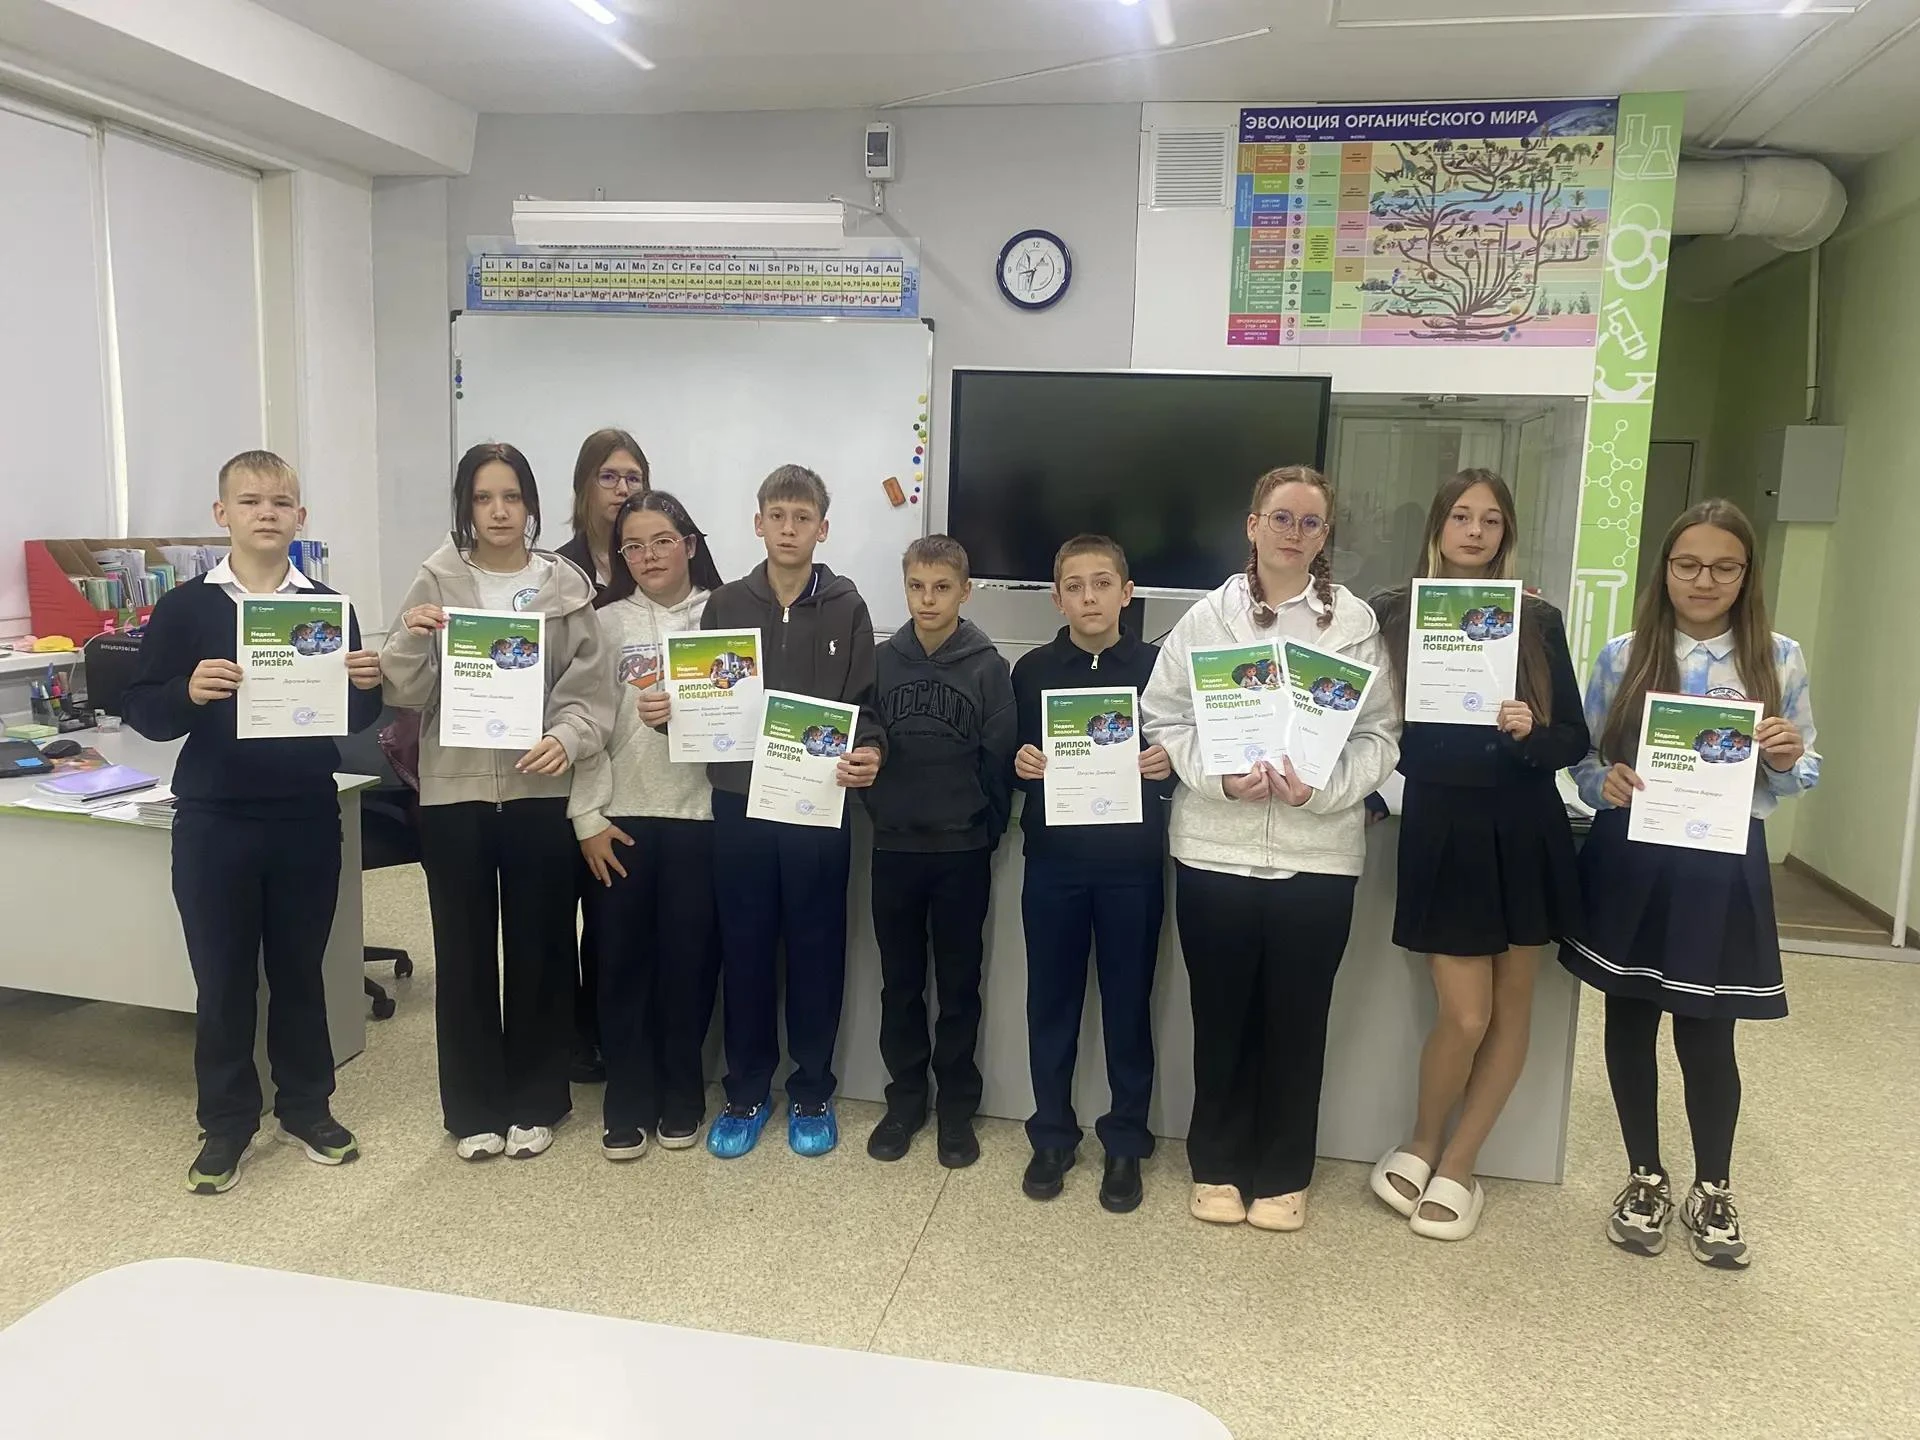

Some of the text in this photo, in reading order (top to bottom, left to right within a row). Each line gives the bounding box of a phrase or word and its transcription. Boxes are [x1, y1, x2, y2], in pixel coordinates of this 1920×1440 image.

[1245, 110, 1538, 131] ЭВОЛЮЦИЯ ОРГАНИЧЕСКОГО МИРА
[595, 263, 609, 272] Mg
[808, 265, 818, 274] H2
[846, 265, 859, 274] Hg
[866, 265, 879, 274] Ag
[1423, 634, 1464, 643] ДИПЛОМ
[1422, 643, 1484, 652] ПОБЕДИТЕЛЯ
[251, 650, 294, 659] ДИПЛОМ
[252, 658, 294, 667] ПРИЗЁРА
[454, 661, 493, 671] ДИПЛОМ
[454, 669, 492, 678] ПРИЗЁРА
[678, 683, 715, 692] ДИПЛОМ
[679, 691, 734, 699] ПОБЕДИТЕЛЯ
[1205, 694, 1241, 702] ДИПЛОМ
[1206, 699, 1261, 709] ПОБЕДИТЕЛЯ
[767, 742, 804, 755] ДИПЛОМ
[1055, 741, 1091, 749] ДИПЛОМ
[766, 750, 801, 762] ПРИЗЁРА
[1055, 748, 1090, 757] ПРИЗЁРА
[1652, 752, 1696, 763] ДИПЛОМ
[1651, 761, 1695, 772] ПРИЗЁРА
